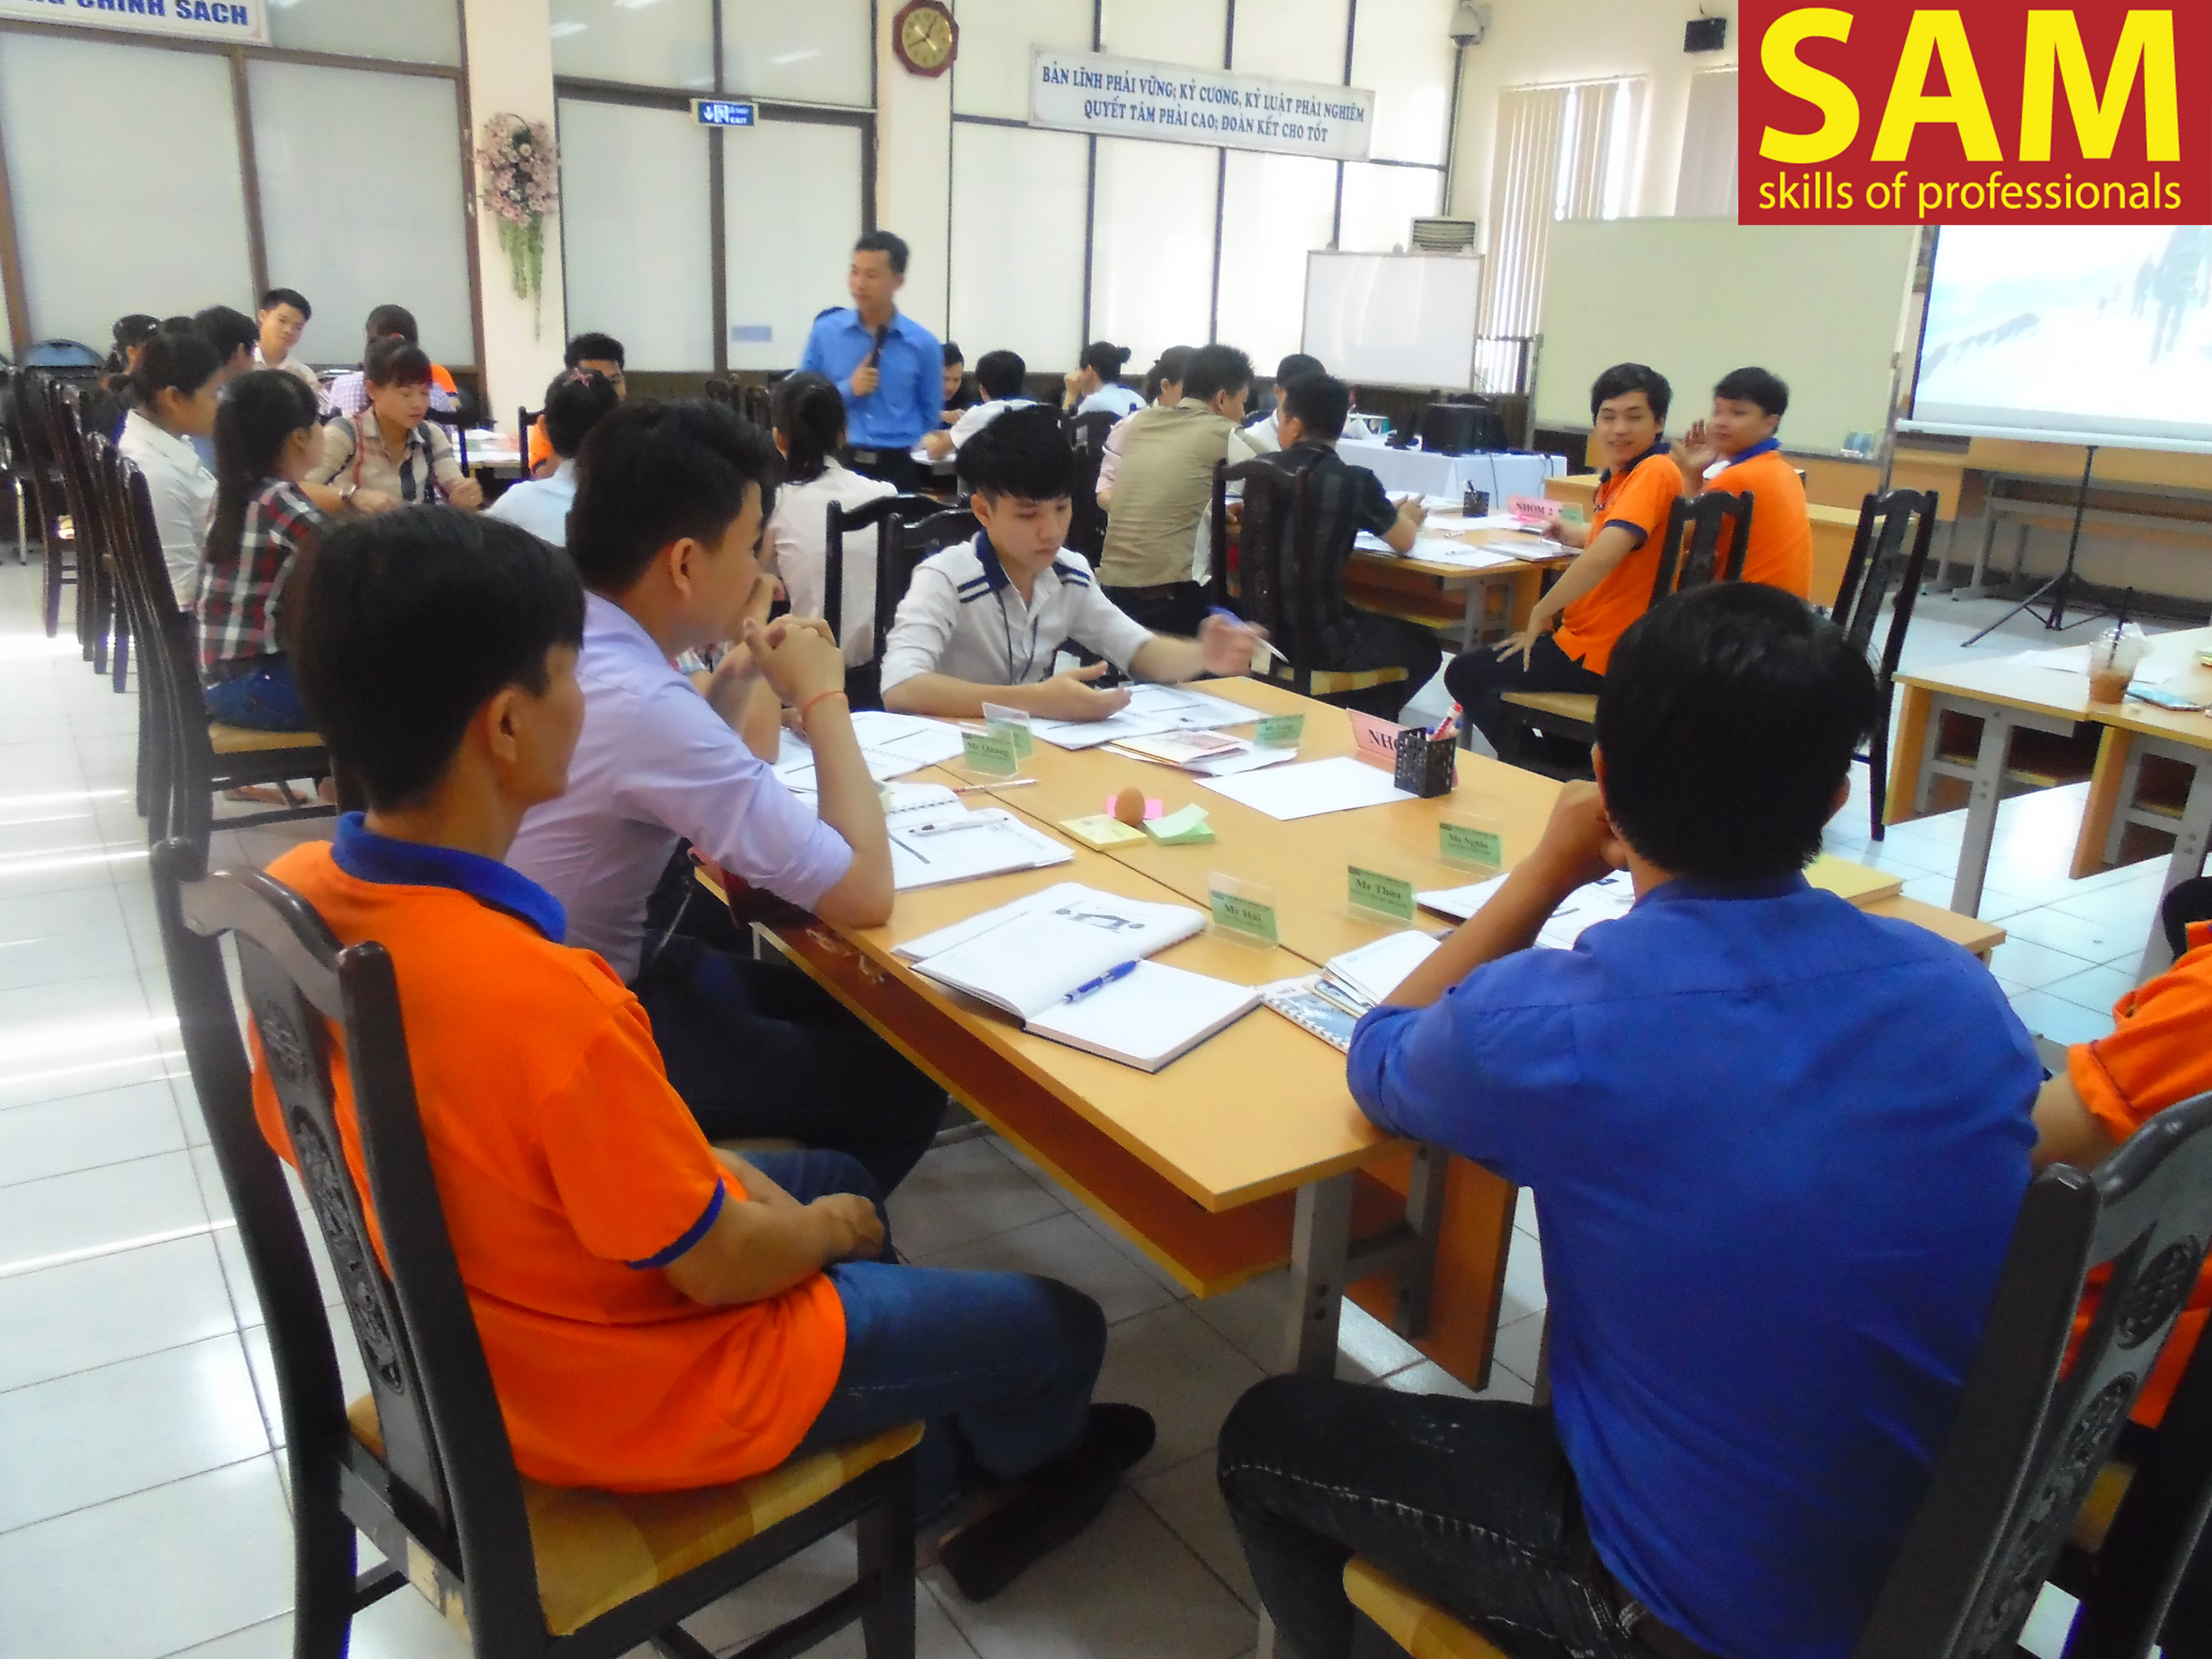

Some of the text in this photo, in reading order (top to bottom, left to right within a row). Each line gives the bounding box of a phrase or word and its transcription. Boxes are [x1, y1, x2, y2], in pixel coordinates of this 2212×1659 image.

[1042, 60, 1069, 84] BẢN
[1073, 66, 1103, 90] LĨNH
[1106, 70, 1136, 94] PHẢI
[1263, 92, 1293, 116] LUẬT
[1296, 95, 1322, 117] PHẢI
[1324, 102, 1365, 122] NGHIÊM
[1084, 96, 1127, 119] QUYẾT
[1130, 101, 1155, 122] TÂM
[1159, 103, 1188, 126] PHẢI
[1221, 113, 1254, 133] ĐOÀN
[1257, 115, 1279, 136] KẾT
[1281, 123, 1304, 139] CHO
[1307, 120, 1328, 142] TỐT
[1357, 878, 1371, 890] Mr
[1225, 903, 1239, 915] Mr
